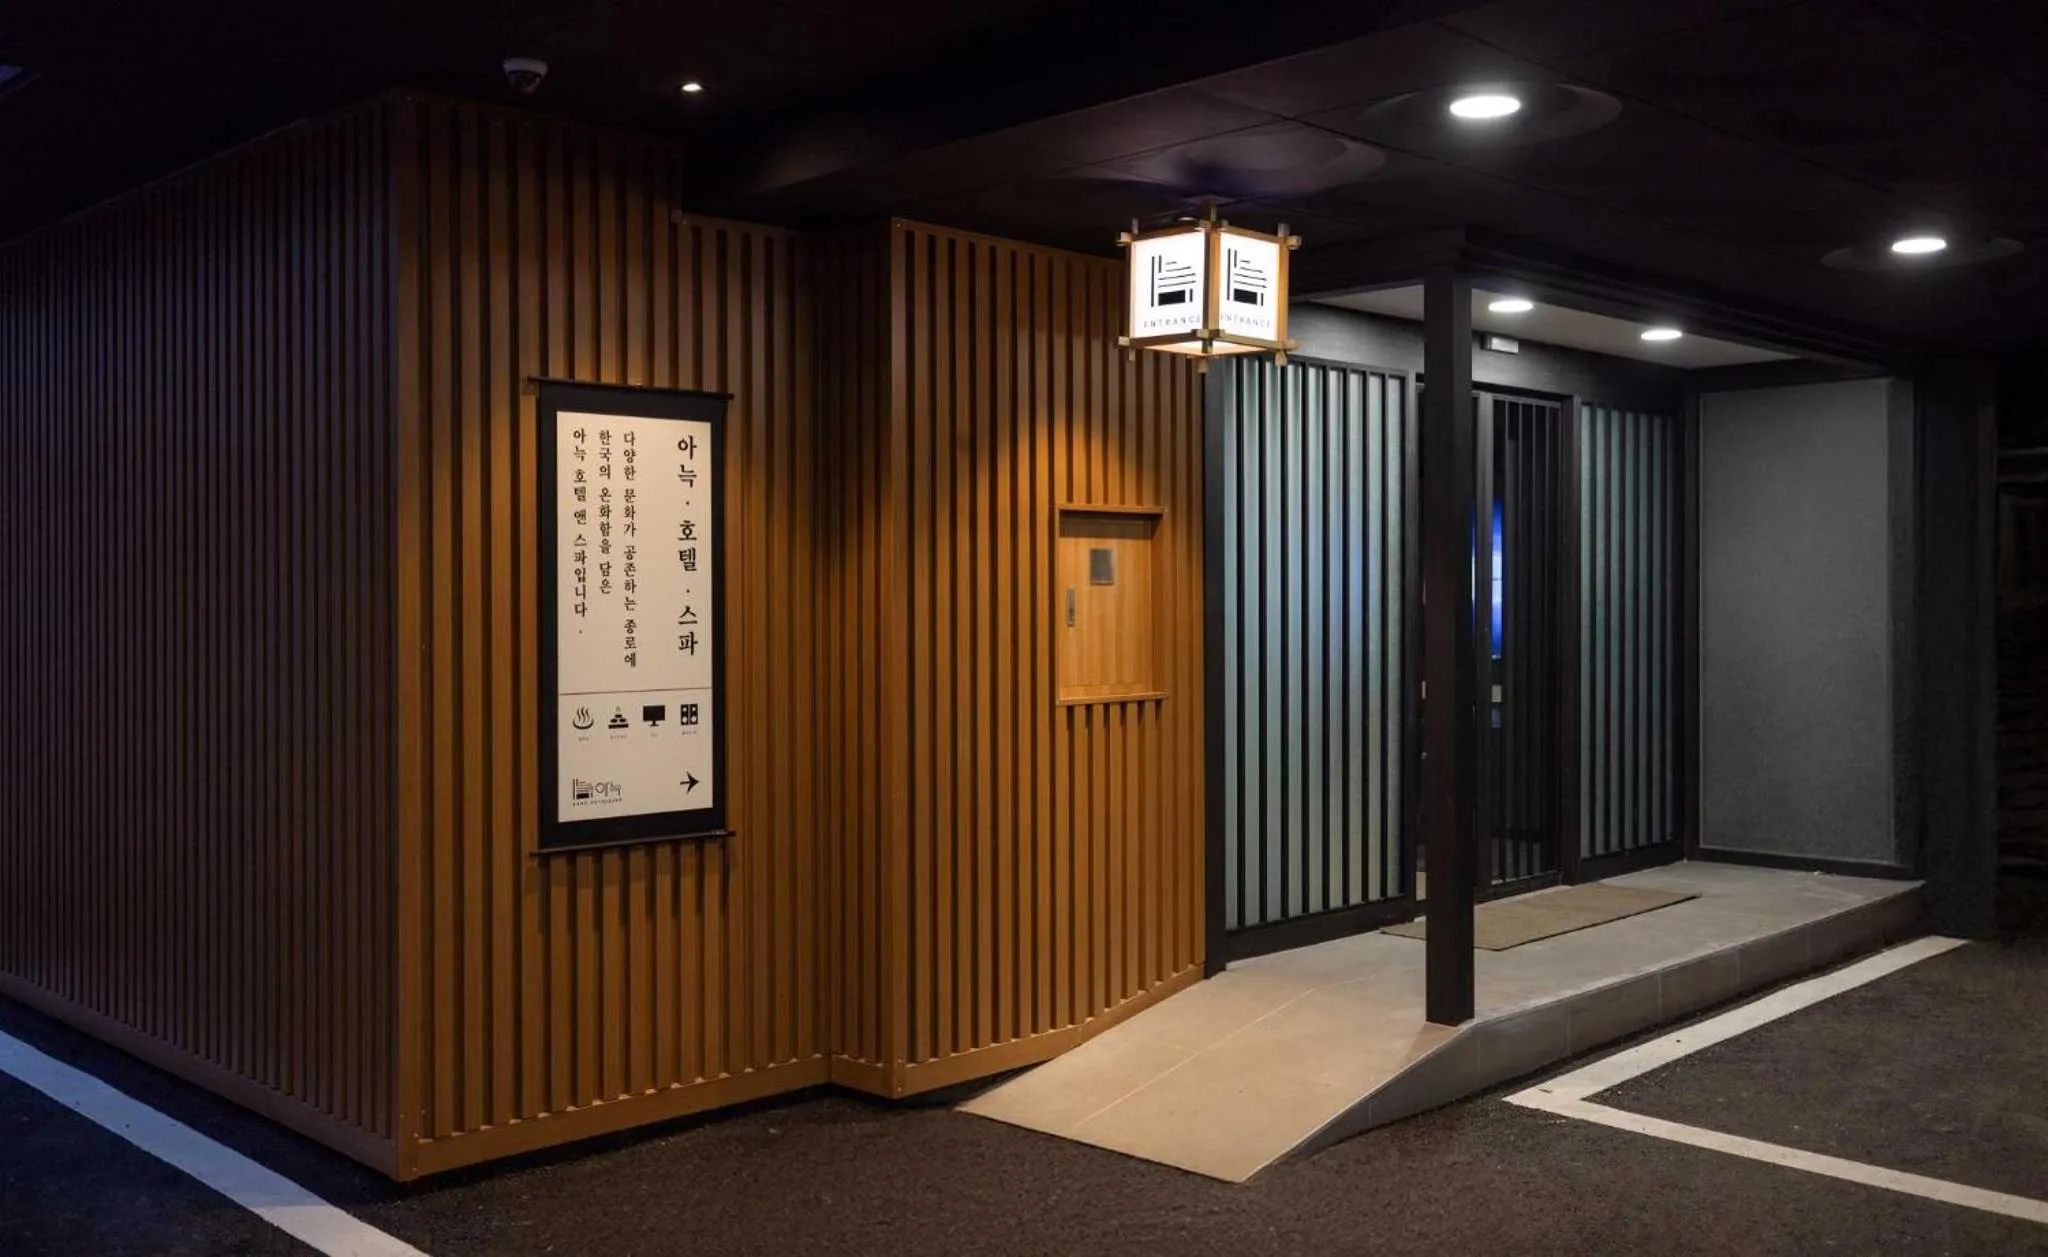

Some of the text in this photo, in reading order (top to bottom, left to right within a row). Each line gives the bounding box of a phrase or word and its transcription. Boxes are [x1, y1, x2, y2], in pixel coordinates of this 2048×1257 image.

[1144, 314, 1200, 328] ENTRANCE
[572, 427, 587, 463] 아늑
[573, 468, 587, 503] 호텔
[573, 508, 587, 526] 앤
[598, 429, 613, 595] 한국의 온화함을 담은
[623, 430, 637, 668] 다양한 문화가 공존하는 종로에
[677, 434, 699, 657] 아늑 호텔 스파
